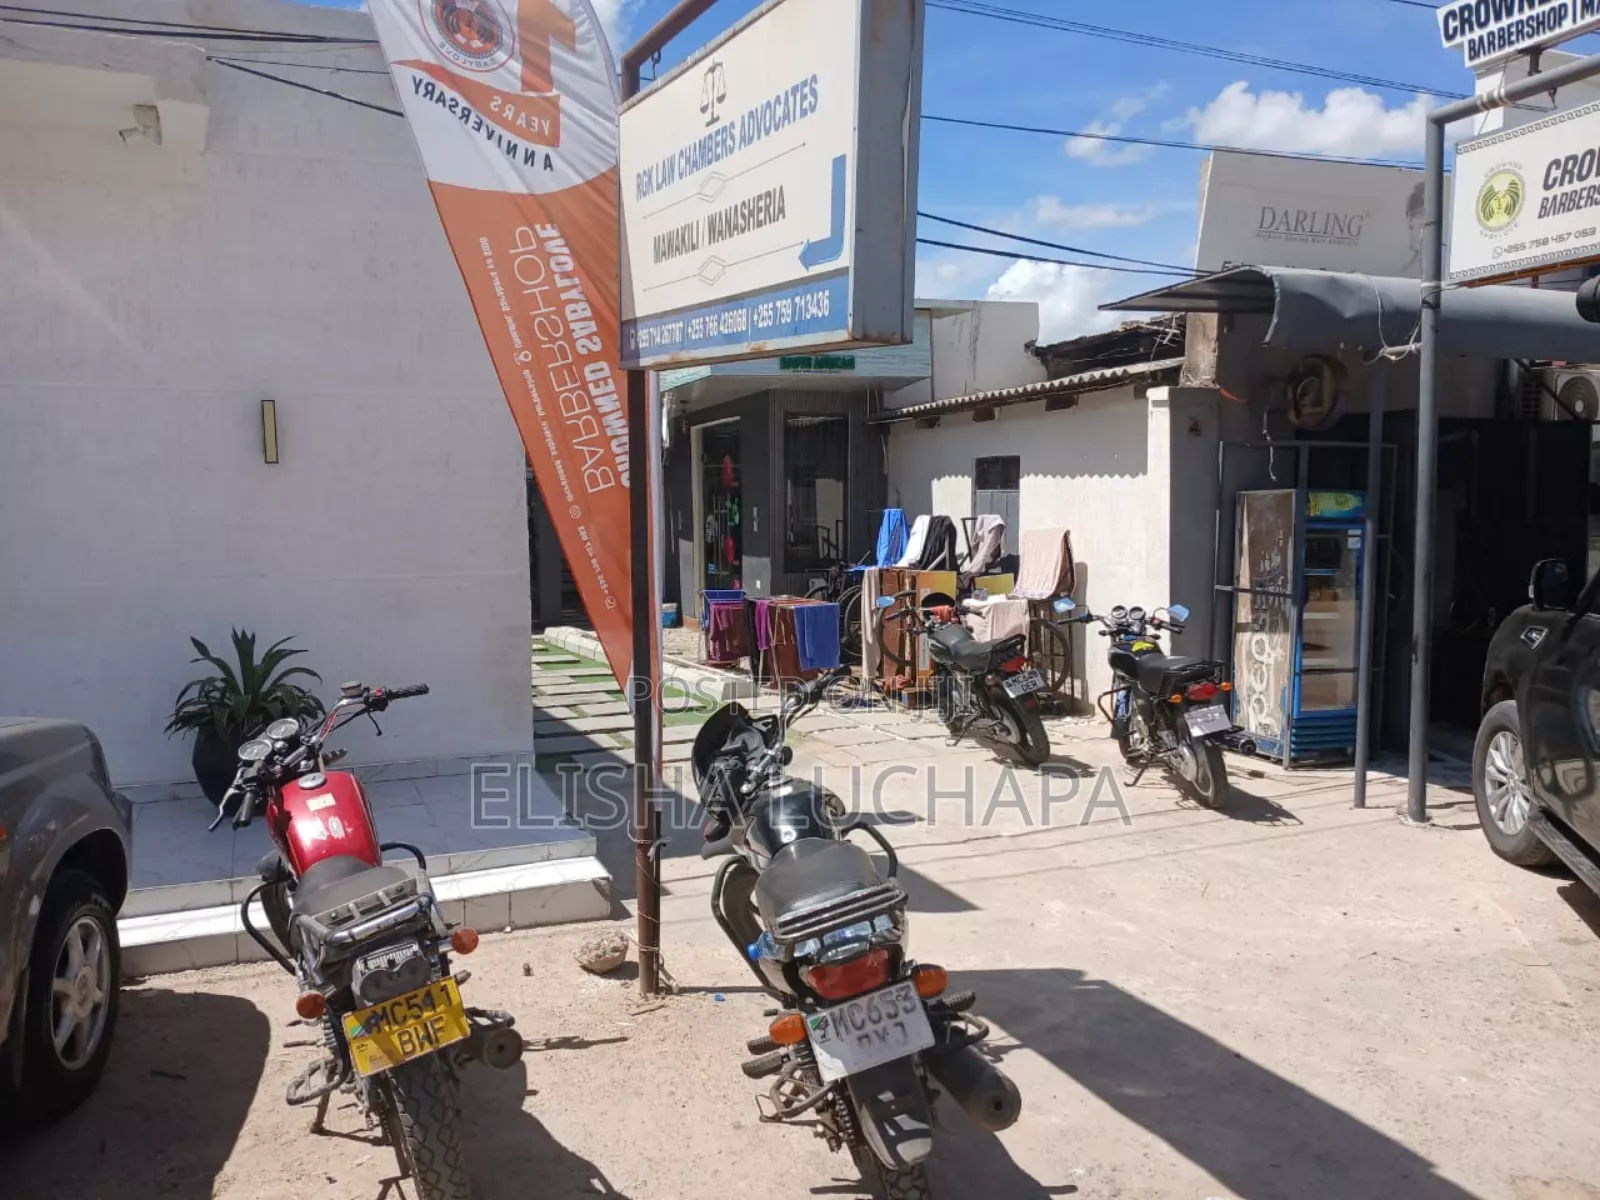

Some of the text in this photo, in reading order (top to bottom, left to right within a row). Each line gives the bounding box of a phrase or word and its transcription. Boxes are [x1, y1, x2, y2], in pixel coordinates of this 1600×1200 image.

[1443, 0, 1556, 42] CROW
[1468, 3, 1569, 62] BARBERSHOP
[636, 74, 819, 201] RGK LAW CHAMBERS ADVOCATES
[1543, 147, 1600, 191] CRO
[653, 220, 700, 265] MAWAKILI
[707, 184, 786, 246] WANASHERIA
[1258, 206, 1364, 238] DARLING
[753, 302, 774, 328] +255
[794, 289, 830, 322] 713436
